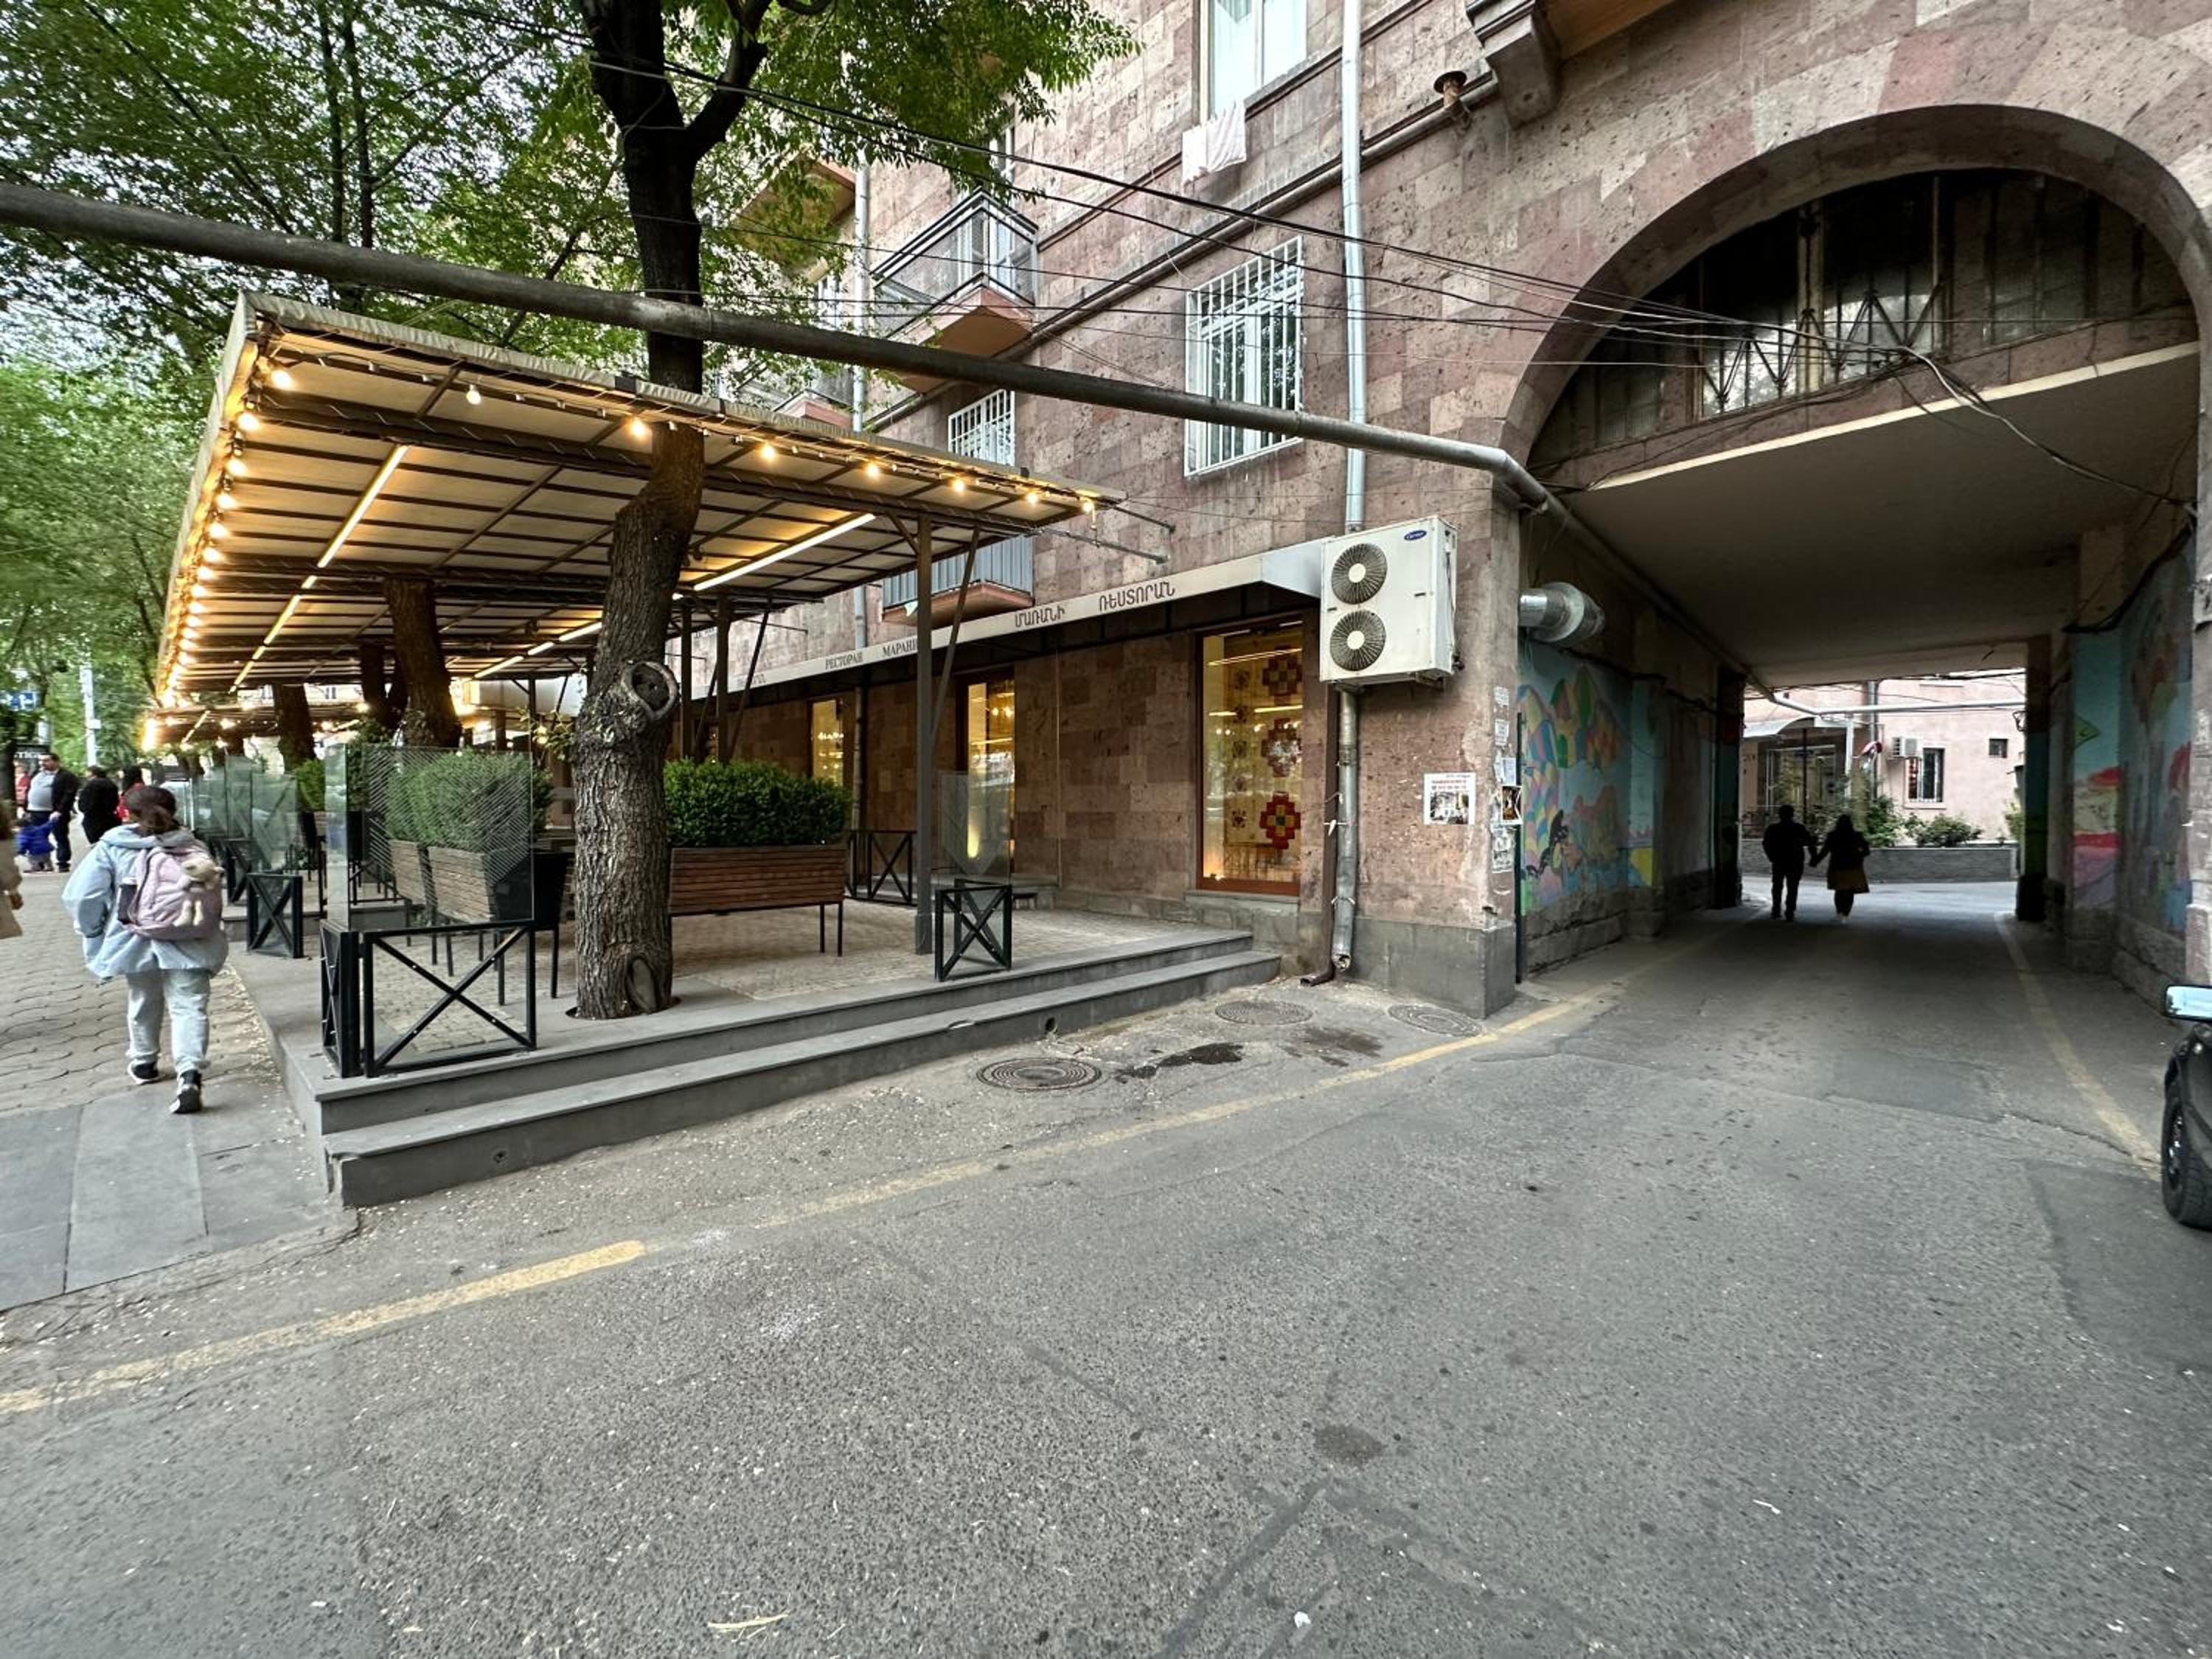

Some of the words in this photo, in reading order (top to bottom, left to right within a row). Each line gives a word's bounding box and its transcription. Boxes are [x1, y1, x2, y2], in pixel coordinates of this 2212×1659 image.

[1015, 605, 1065, 627] ՄԱՌԱՆԻ
[1099, 581, 1175, 611] ՌԵՍՏՈՐԱՆ
[826, 651, 863, 669] РЕСТОРАН
